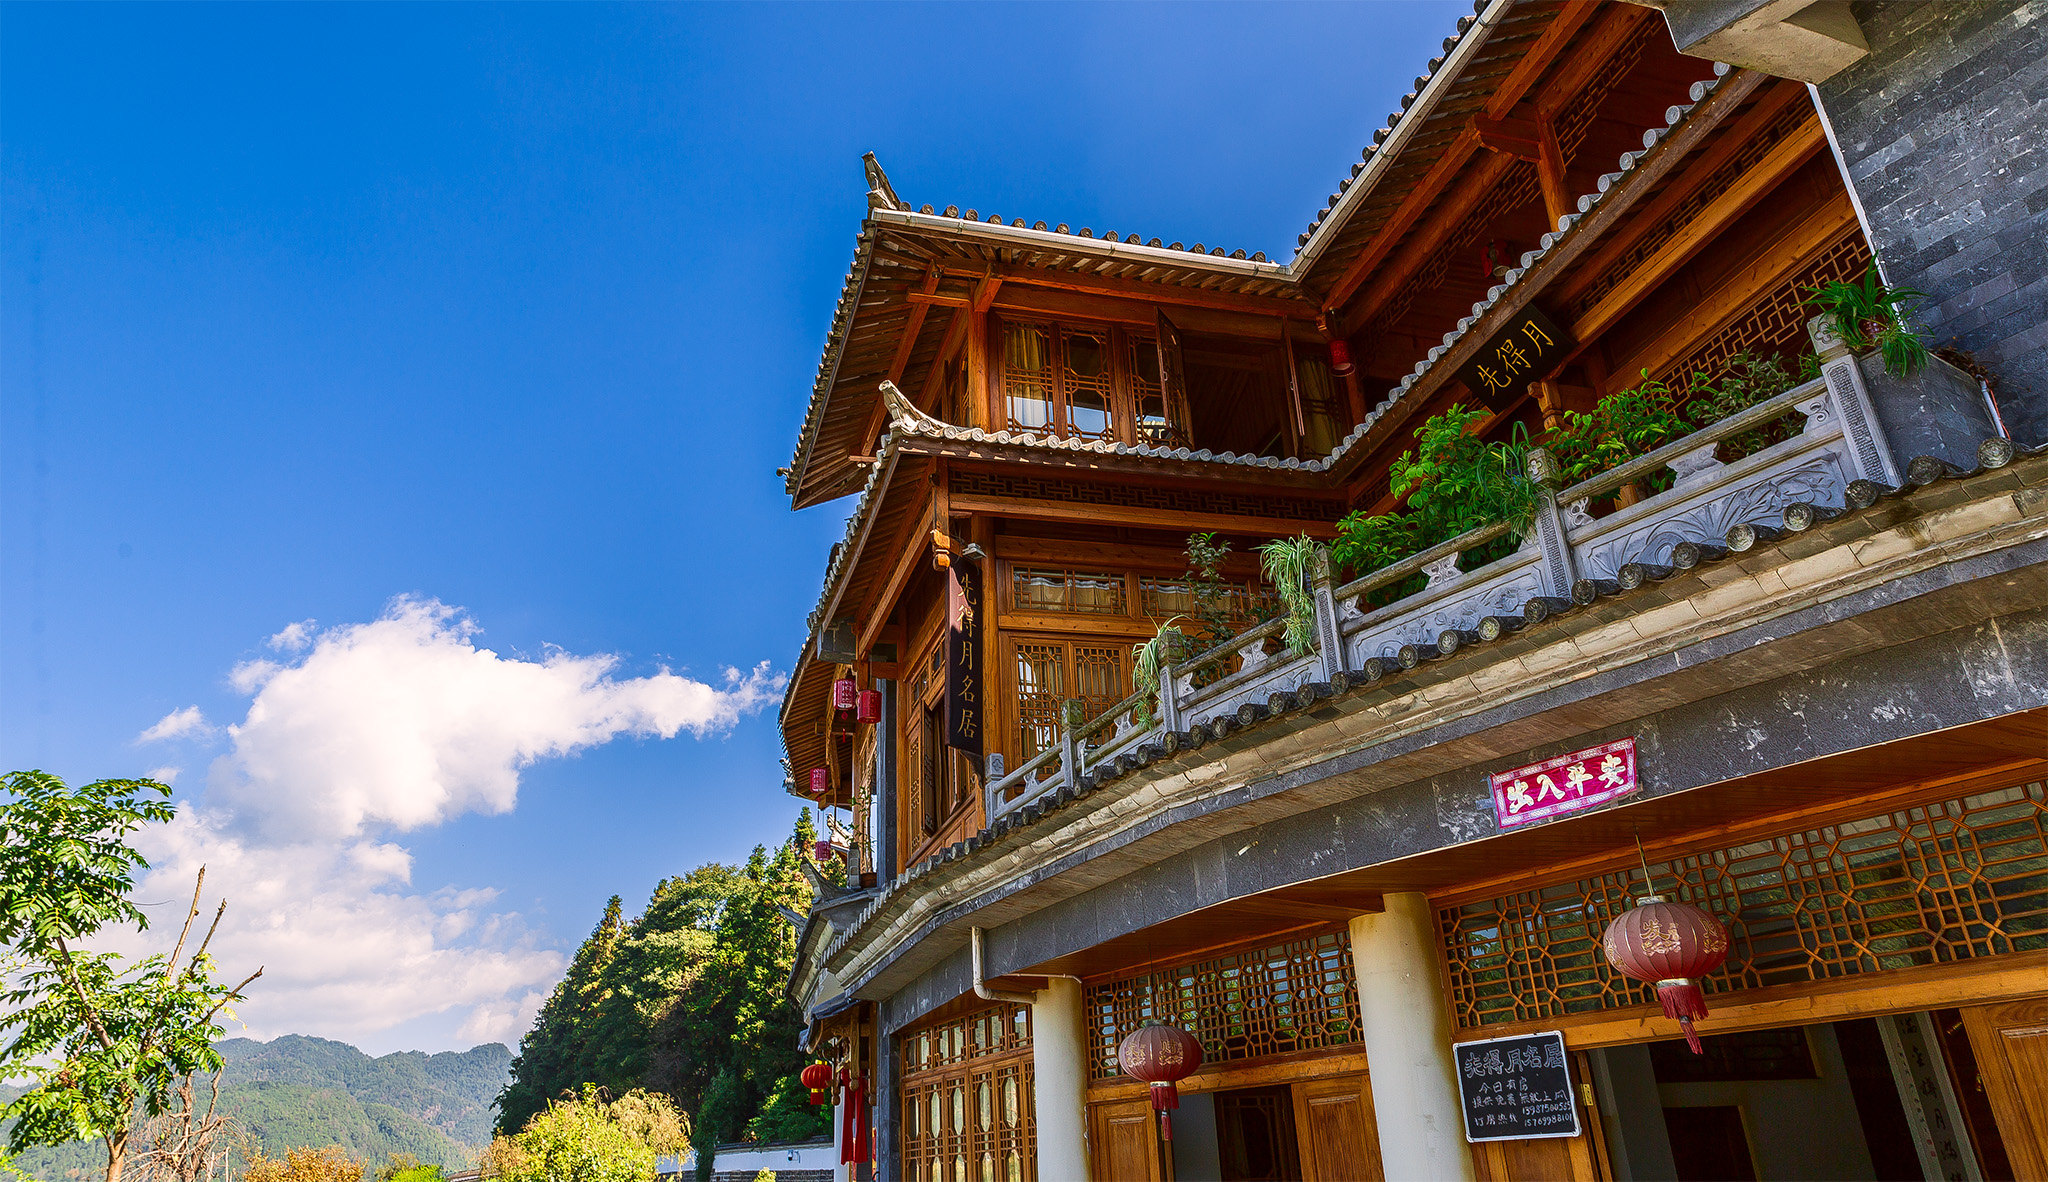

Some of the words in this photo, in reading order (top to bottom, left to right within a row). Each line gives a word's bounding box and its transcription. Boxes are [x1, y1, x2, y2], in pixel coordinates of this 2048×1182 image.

[1477, 320, 1554, 396] 先得月
[956, 573, 977, 739] 先得月名居
[1506, 753, 1626, 814] 出入平安
[1464, 1042, 1563, 1078] 先得月名居
[1479, 1076, 1528, 1094] 今日有房
